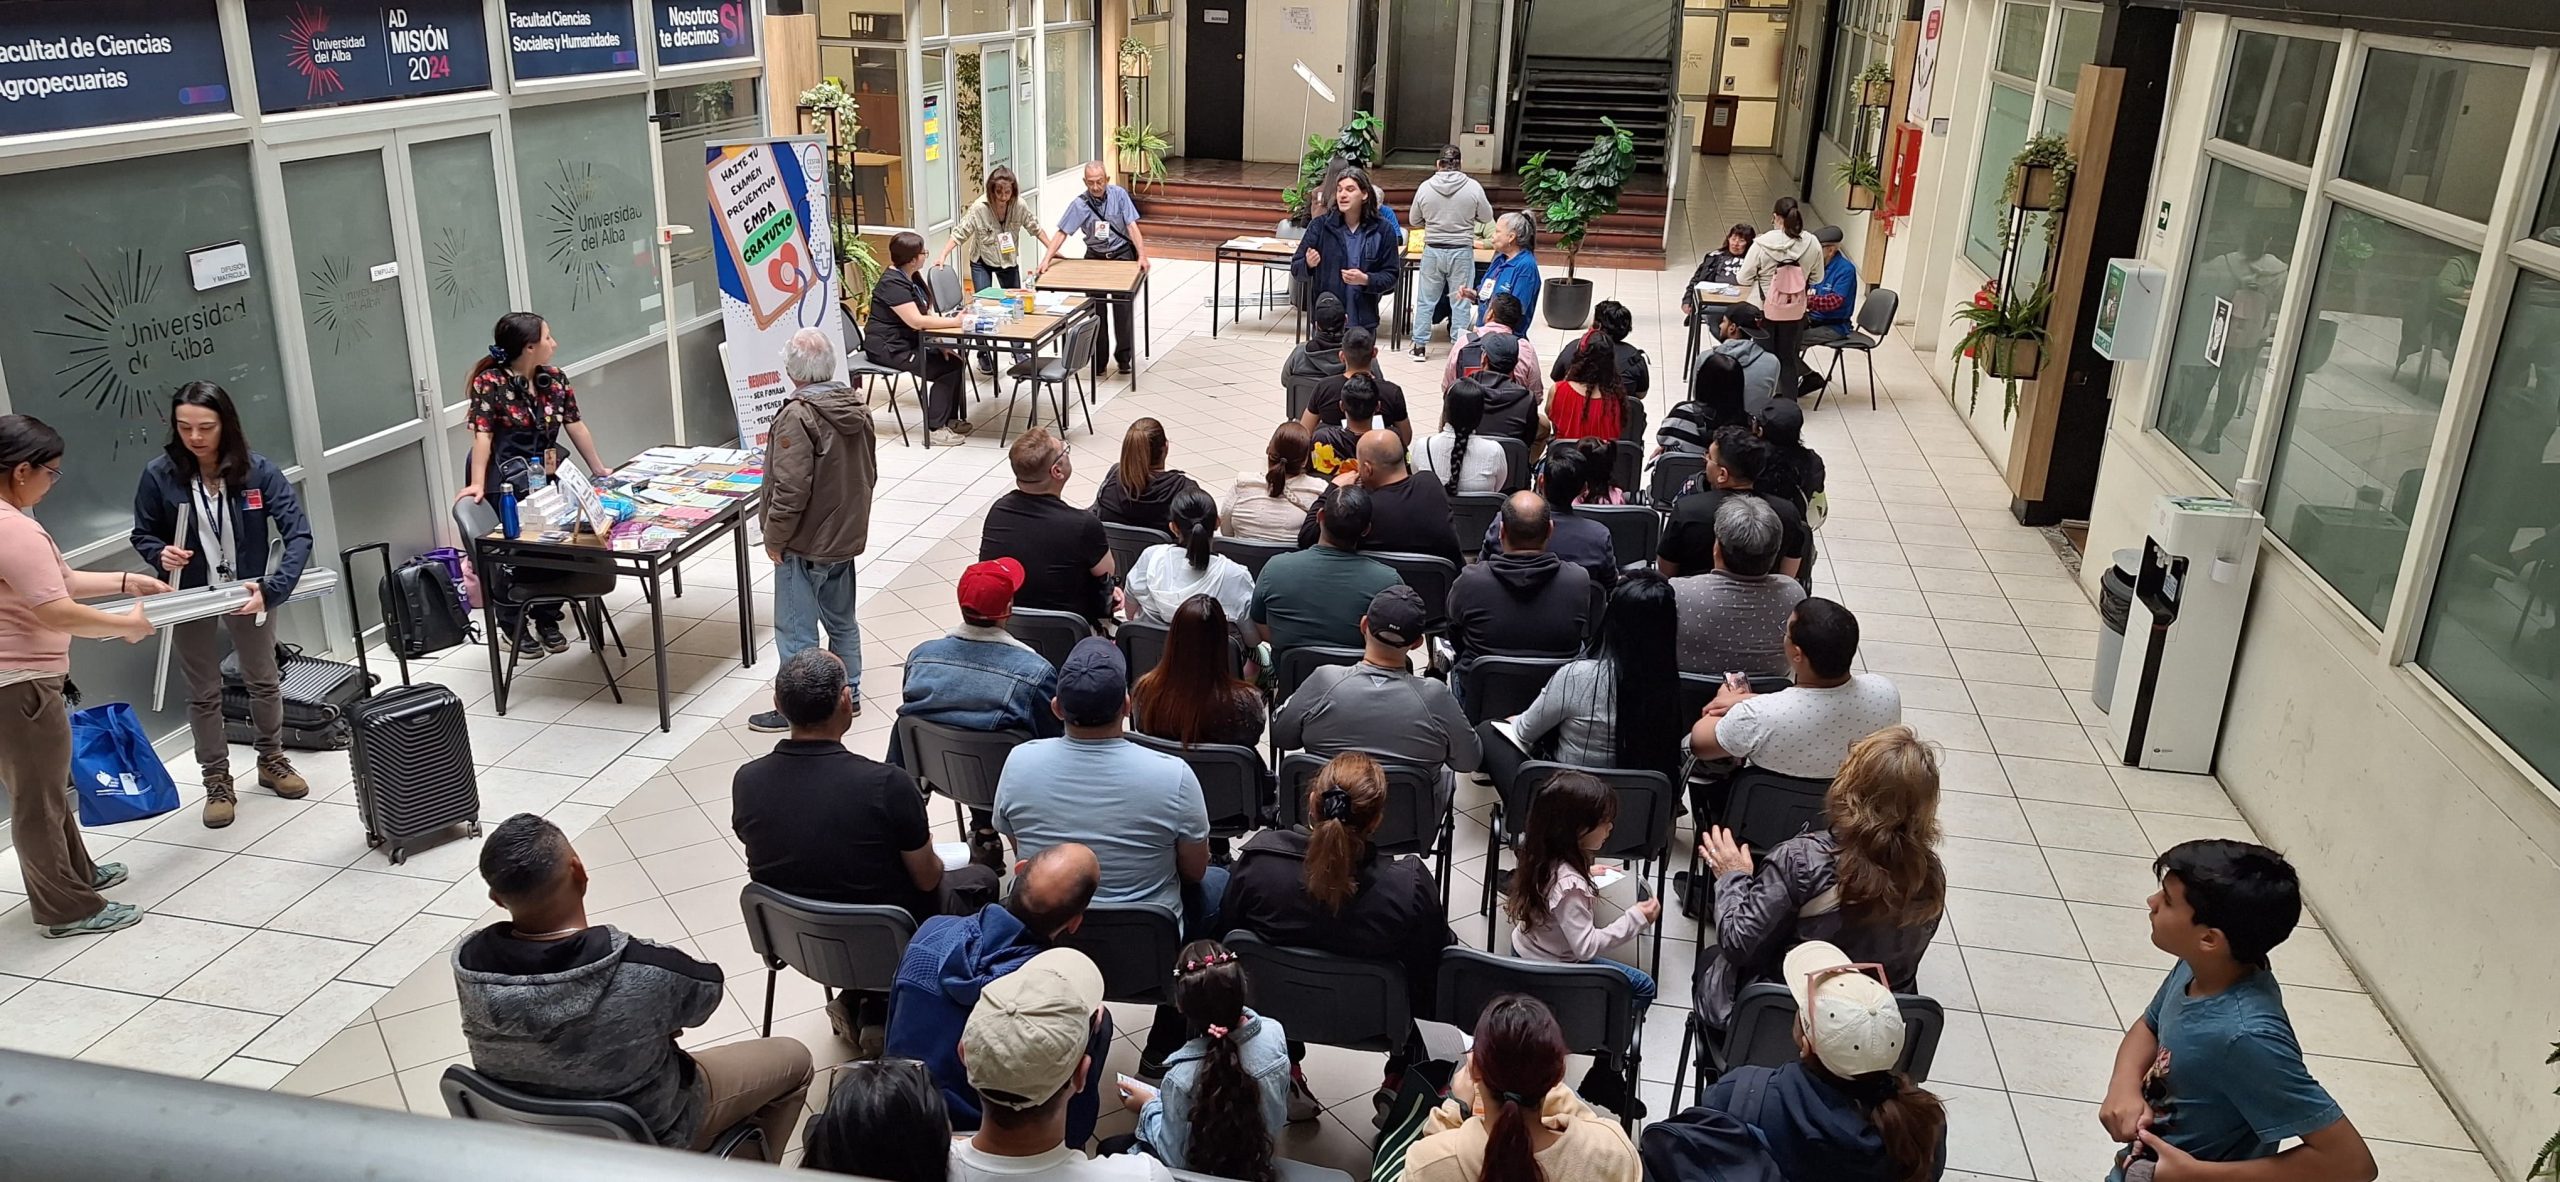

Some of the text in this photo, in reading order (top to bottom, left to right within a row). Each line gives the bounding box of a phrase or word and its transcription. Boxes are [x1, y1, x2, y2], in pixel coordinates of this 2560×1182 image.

[388, 9, 408, 28] AD
[510, 10, 591, 28] Facultad Ciencias
[669, 6, 719, 26] Nosotros
[0, 34, 172, 63] acultad de Ciencias
[312, 35, 365, 51] Universidad
[390, 25, 449, 54] MISIÓN
[513, 31, 620, 52] Sociales y Humanidades
[660, 26, 720, 48] te decimos
[315, 49, 352, 63] del Alba
[409, 55, 450, 81] 2024
[0, 68, 128, 101] Agropecuarias
[720, 147, 760, 182] HAZTE TU
[730, 166, 763, 196] EXAMEN
[726, 175, 776, 220] PREVENTIVO
[578, 204, 642, 232] Universidad
[743, 200, 776, 235] EMPA
[581, 227, 626, 251] del Alba
[742, 212, 793, 263] GRATUITO
[374, 267, 395, 276] EMPUJE
[121, 296, 247, 348] Universidad
[748, 371, 781, 389] REQUISITOS:
[754, 386, 785, 399] SER FONASA
[764, 400, 782, 410] TENER
